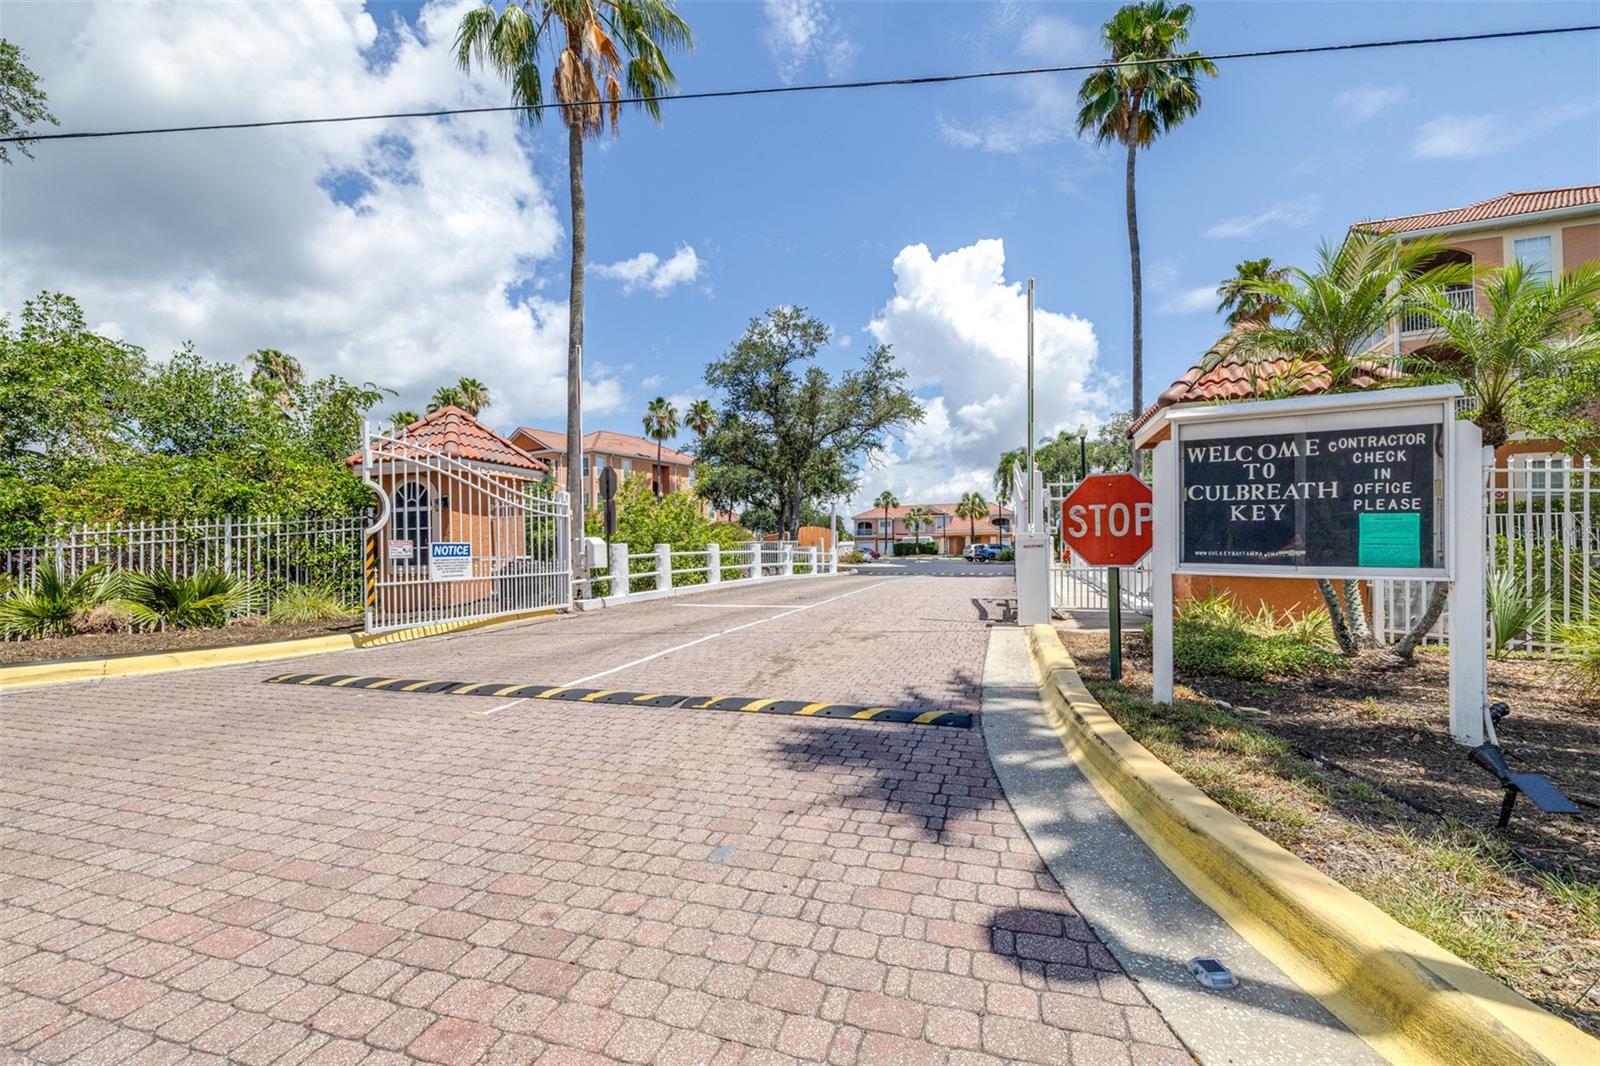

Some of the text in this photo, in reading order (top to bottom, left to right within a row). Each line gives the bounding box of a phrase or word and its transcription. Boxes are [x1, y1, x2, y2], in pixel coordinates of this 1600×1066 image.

[1187, 439, 1319, 463] WELCOME
[1328, 432, 1426, 452] CONTRACTOR
[1243, 462, 1276, 480] TO
[1373, 468, 1391, 480] IN
[1188, 481, 1338, 501] CULBREATH
[1230, 504, 1286, 521] KEY
[1353, 498, 1422, 511] PLEASE
[1068, 502, 1153, 538] STOP
[434, 545, 469, 556] NOTICE
